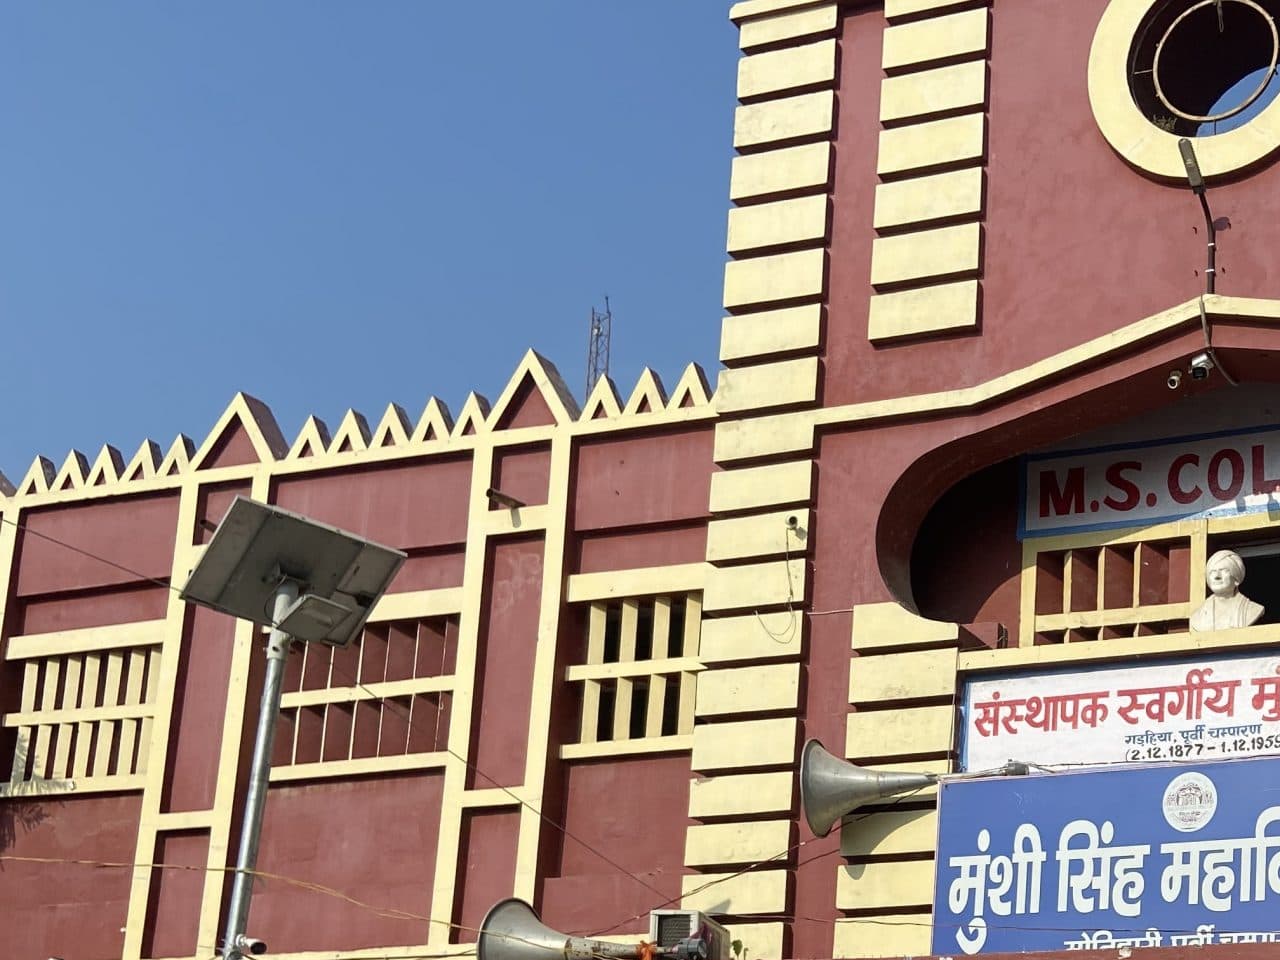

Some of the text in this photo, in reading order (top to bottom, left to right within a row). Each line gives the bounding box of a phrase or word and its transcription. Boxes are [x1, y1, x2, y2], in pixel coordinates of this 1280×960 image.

[1038, 461, 1157, 518] M.S.
[974, 690, 1108, 738] संस्थापक
[1116, 668, 1240, 726] स्वर्गीय
[1182, 724, 1261, 744] पूर्वी चम्पारण
[948, 823, 1046, 955] मुंशी
[1056, 820, 1150, 917] सिंह
